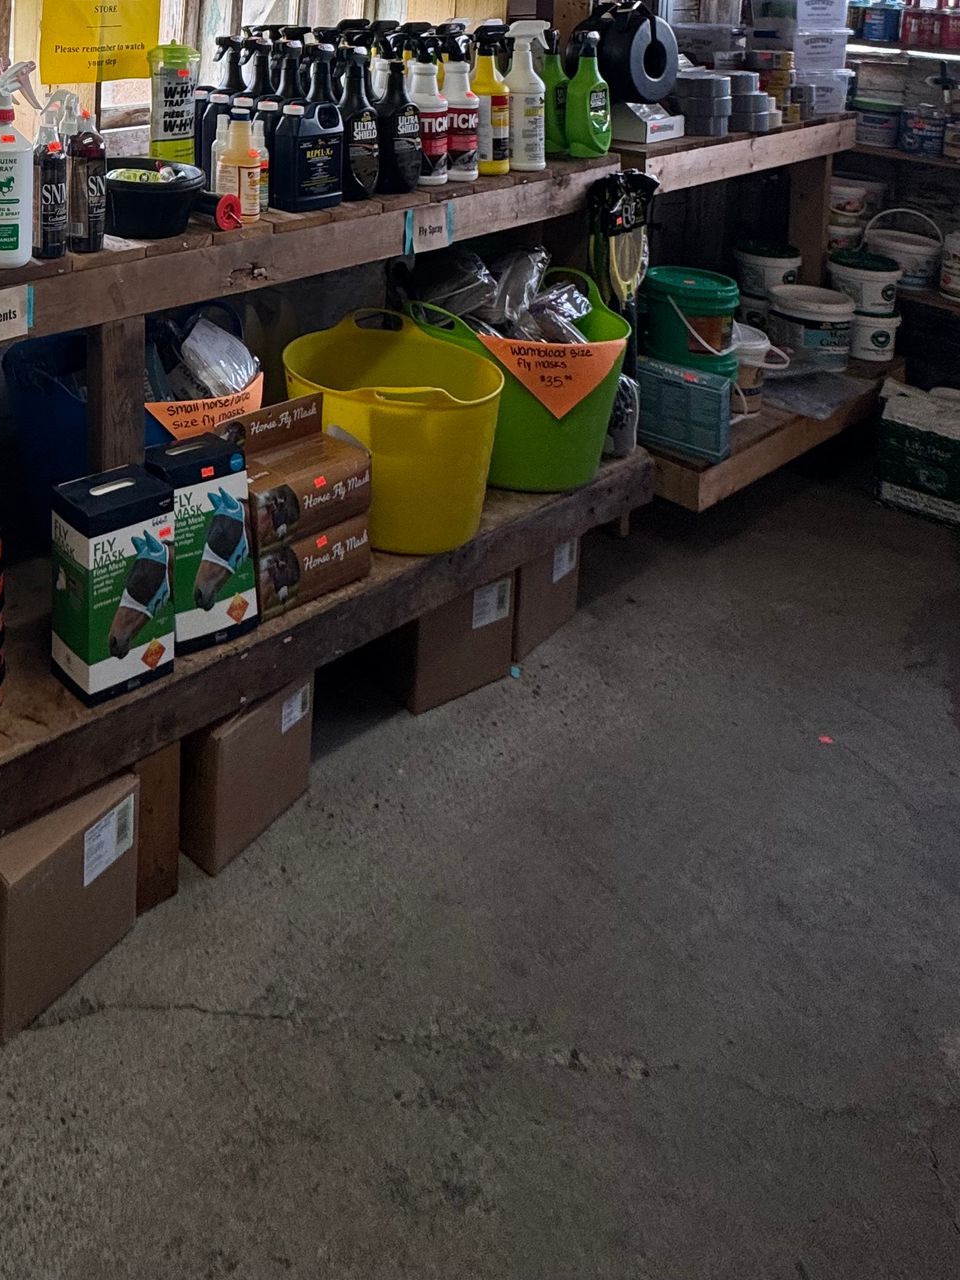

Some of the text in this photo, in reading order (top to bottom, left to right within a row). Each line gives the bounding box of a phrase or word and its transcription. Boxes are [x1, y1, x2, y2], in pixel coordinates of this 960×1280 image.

[94, 5, 118, 13] STORE
[55, 44, 80, 53] Please
[82, 44, 116, 53] remember
[125, 42, 145, 51] watch
[87, 58, 117, 69] your step
[164, 99, 184, 107] TRAP
[354, 121, 376, 131] ULTRA
[398, 115, 418, 125] ULTRA
[353, 129, 378, 140] SHIELD
[398, 123, 420, 134] SHIELD
[419, 225, 443, 236] Fly Spray
[510, 346, 593, 358] Warmblood size
[517, 357, 568, 371] fly masks
[166, 403, 200, 417] Small
[172, 406, 246, 430] size fly masks
[250, 402, 318, 436] Horse Fly Mask
[303, 470, 370, 509] Horse Fly Mask
[54, 518, 69, 539] FLY
[94, 537, 116, 558] FLY
[303, 529, 368, 571] Horse Fly Mask
[93, 548, 126, 571] MASK
